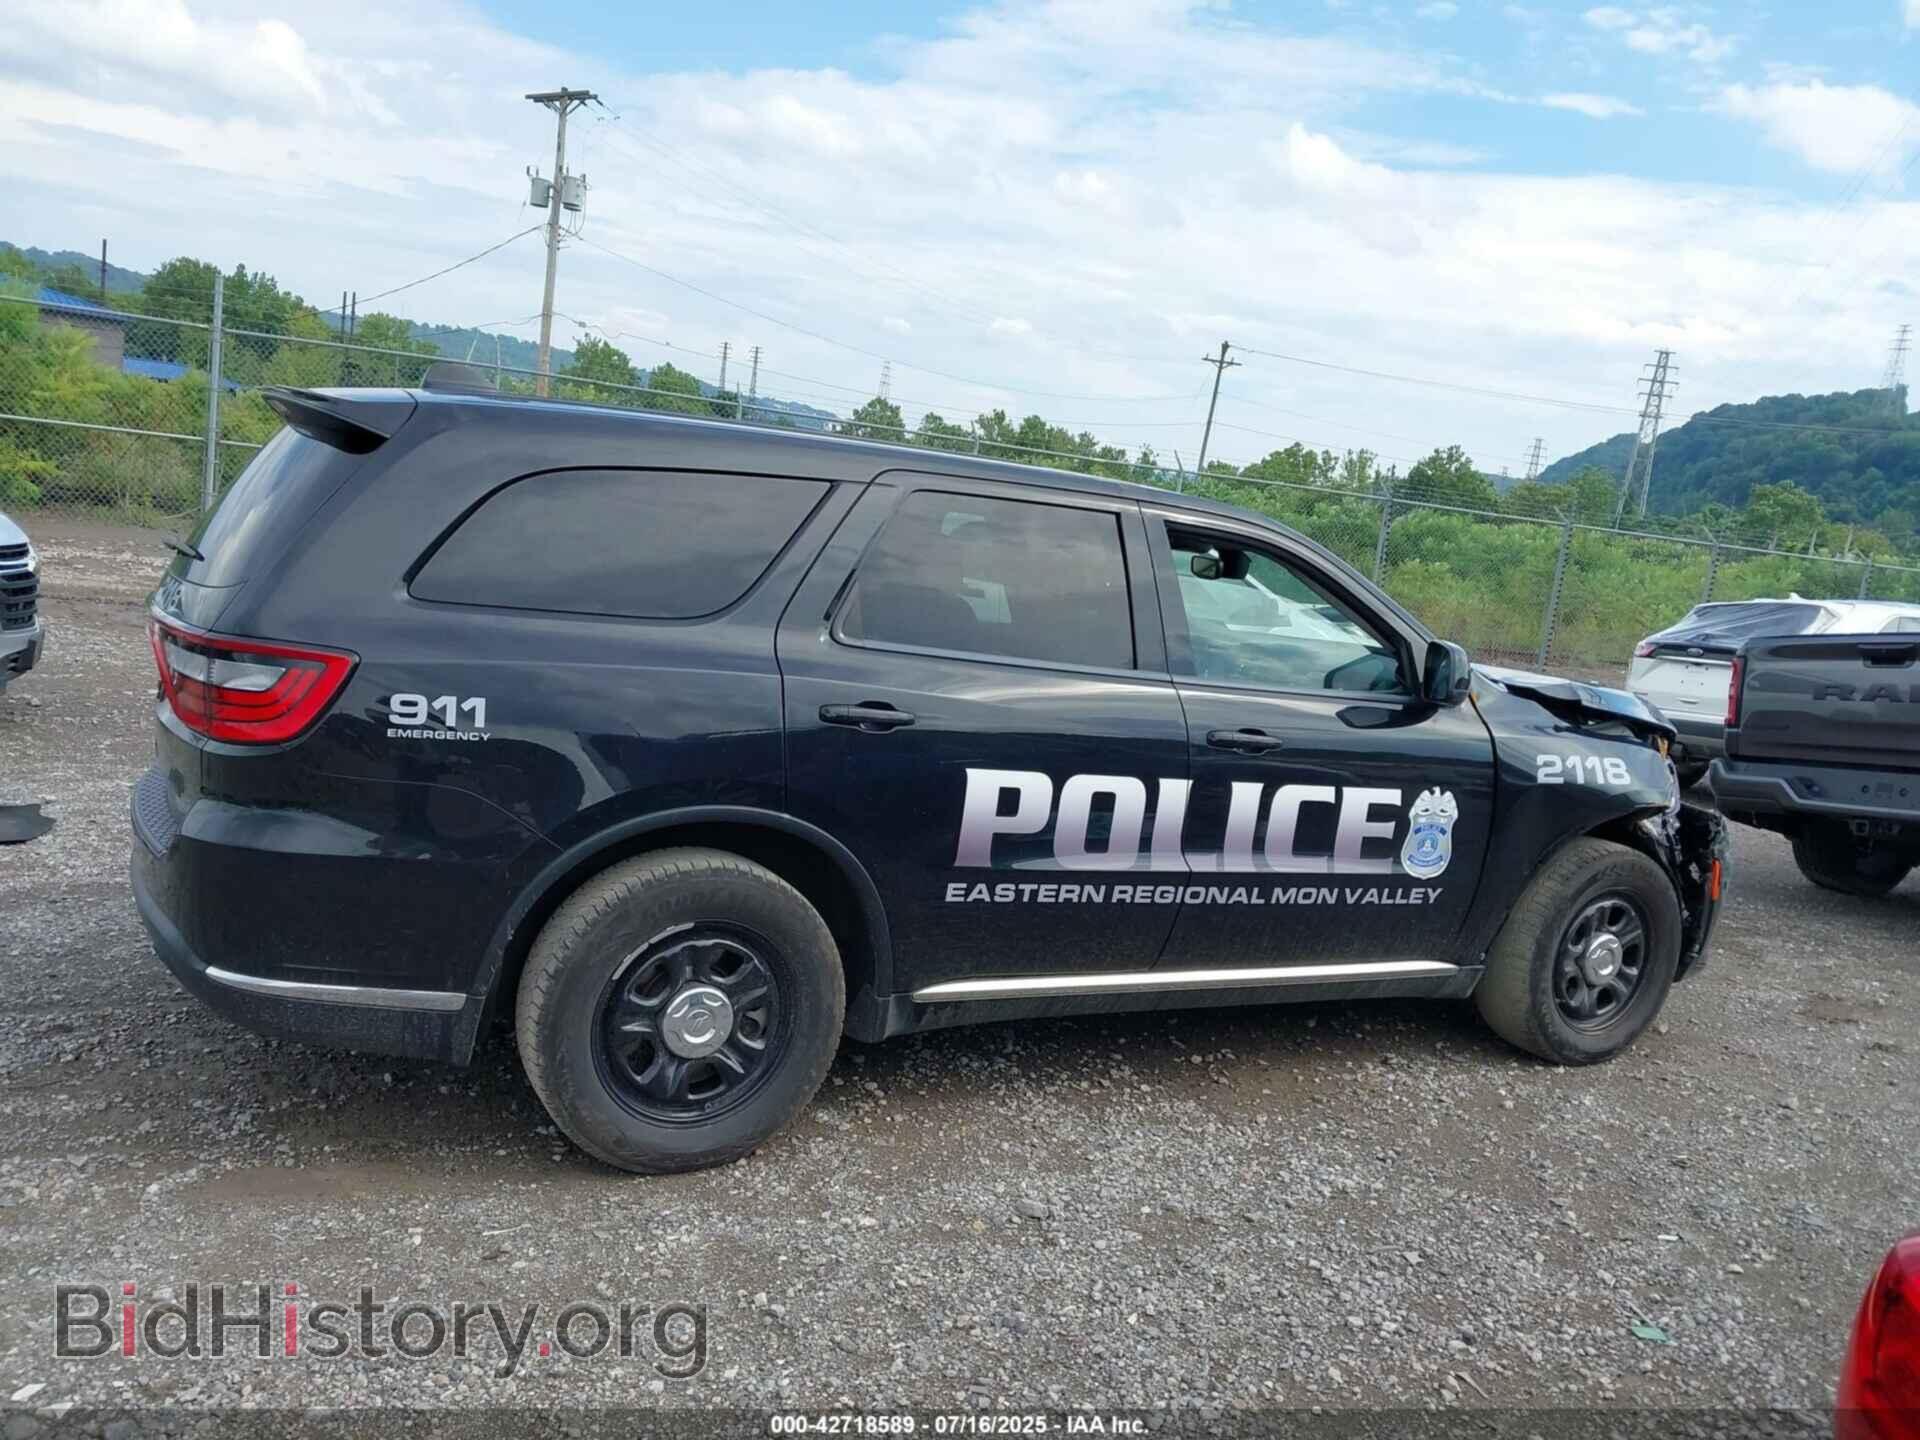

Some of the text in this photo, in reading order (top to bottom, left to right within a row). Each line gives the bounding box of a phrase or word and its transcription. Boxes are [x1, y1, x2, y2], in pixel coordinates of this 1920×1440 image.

[388, 693, 485, 727] 911
[387, 729, 491, 741] EMERGENCY
[1536, 754, 1631, 785] 2118
[953, 768, 1403, 874] POLICE
[945, 883, 1444, 905] EASTERN REGIONAL MON VALLEY
